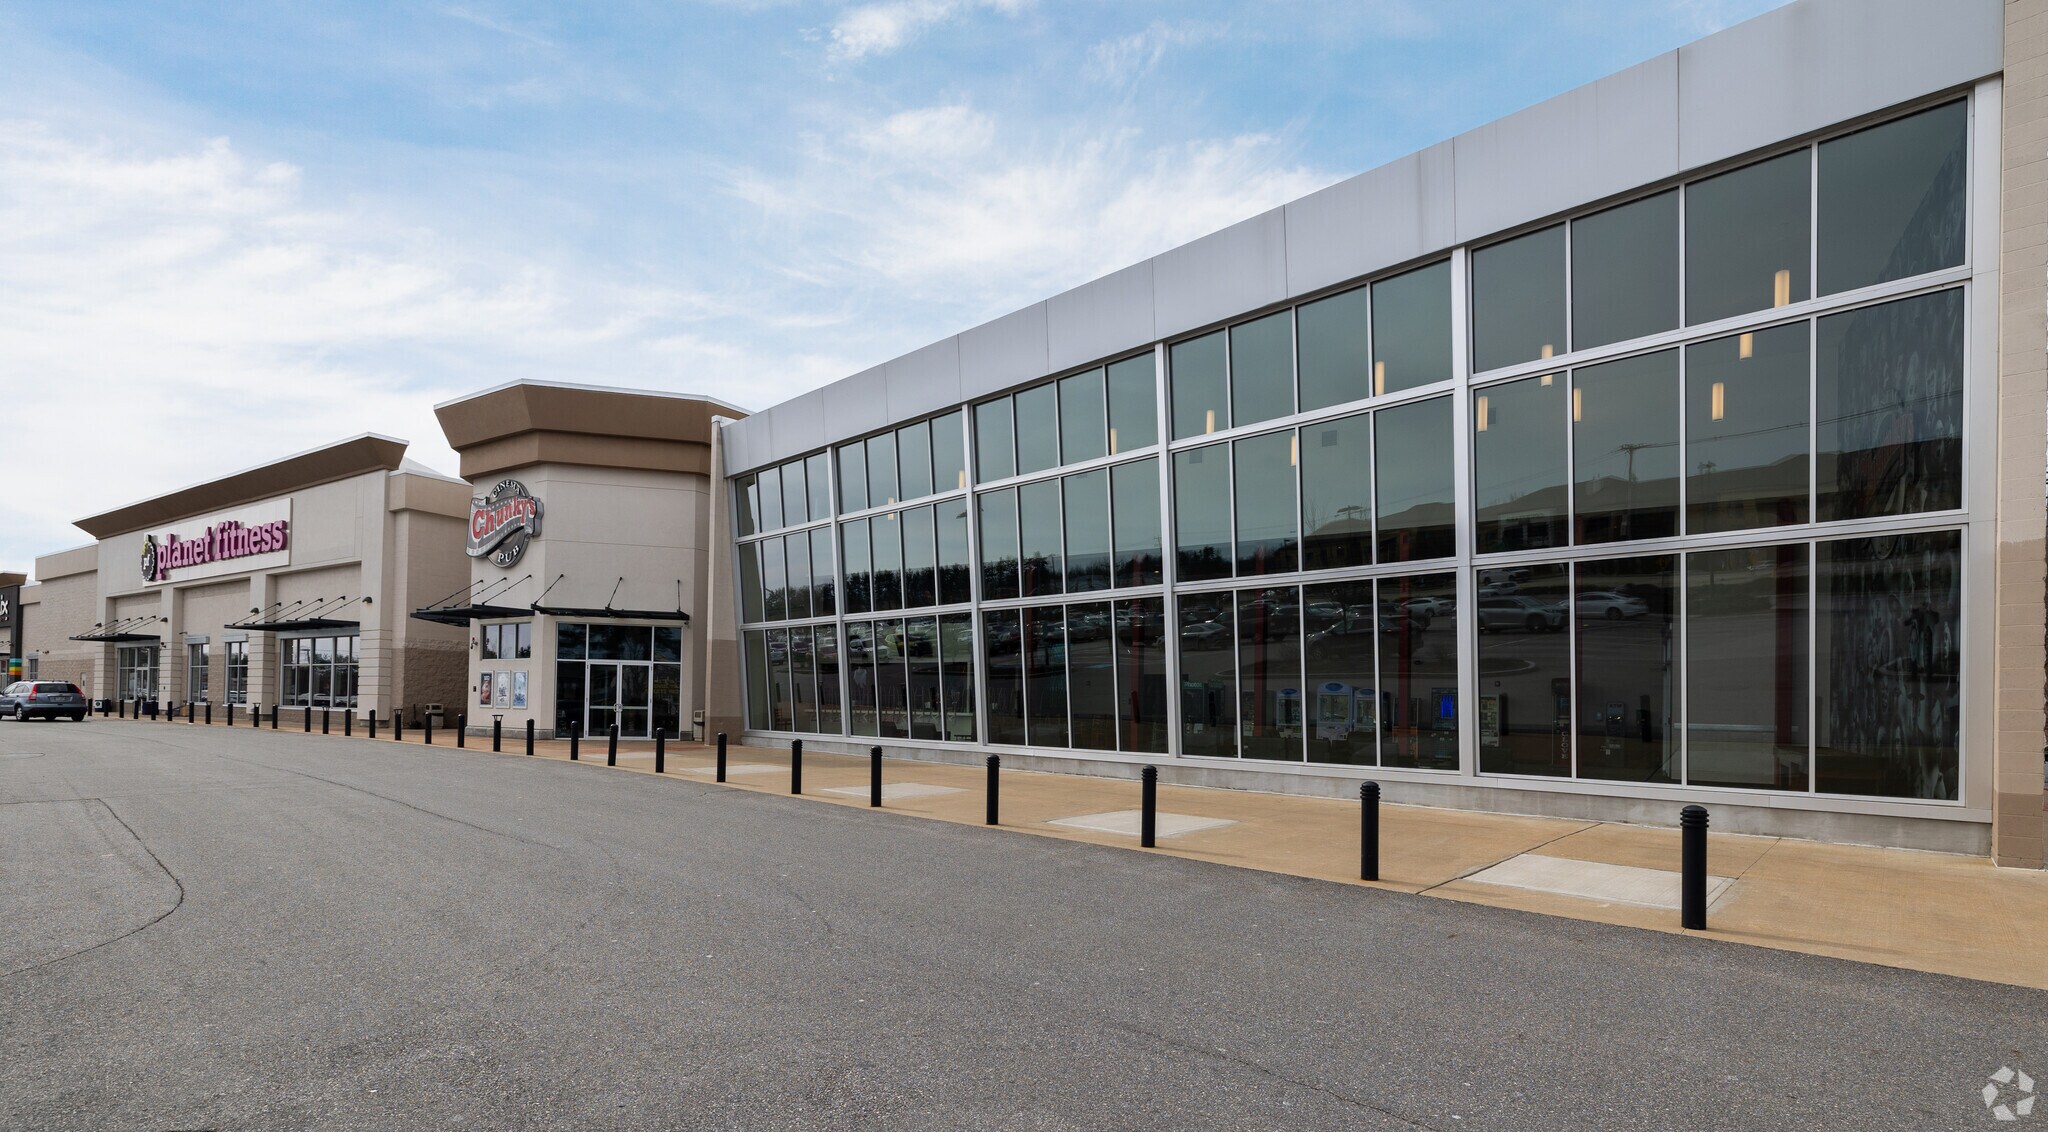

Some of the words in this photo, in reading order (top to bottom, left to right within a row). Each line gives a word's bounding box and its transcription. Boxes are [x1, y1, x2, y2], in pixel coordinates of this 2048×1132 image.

[492, 480, 520, 498] CINEMA
[472, 496, 535, 542] Chunky's
[156, 526, 211, 580] planet
[214, 520, 287, 560] fitness
[498, 545, 519, 562] PUB
